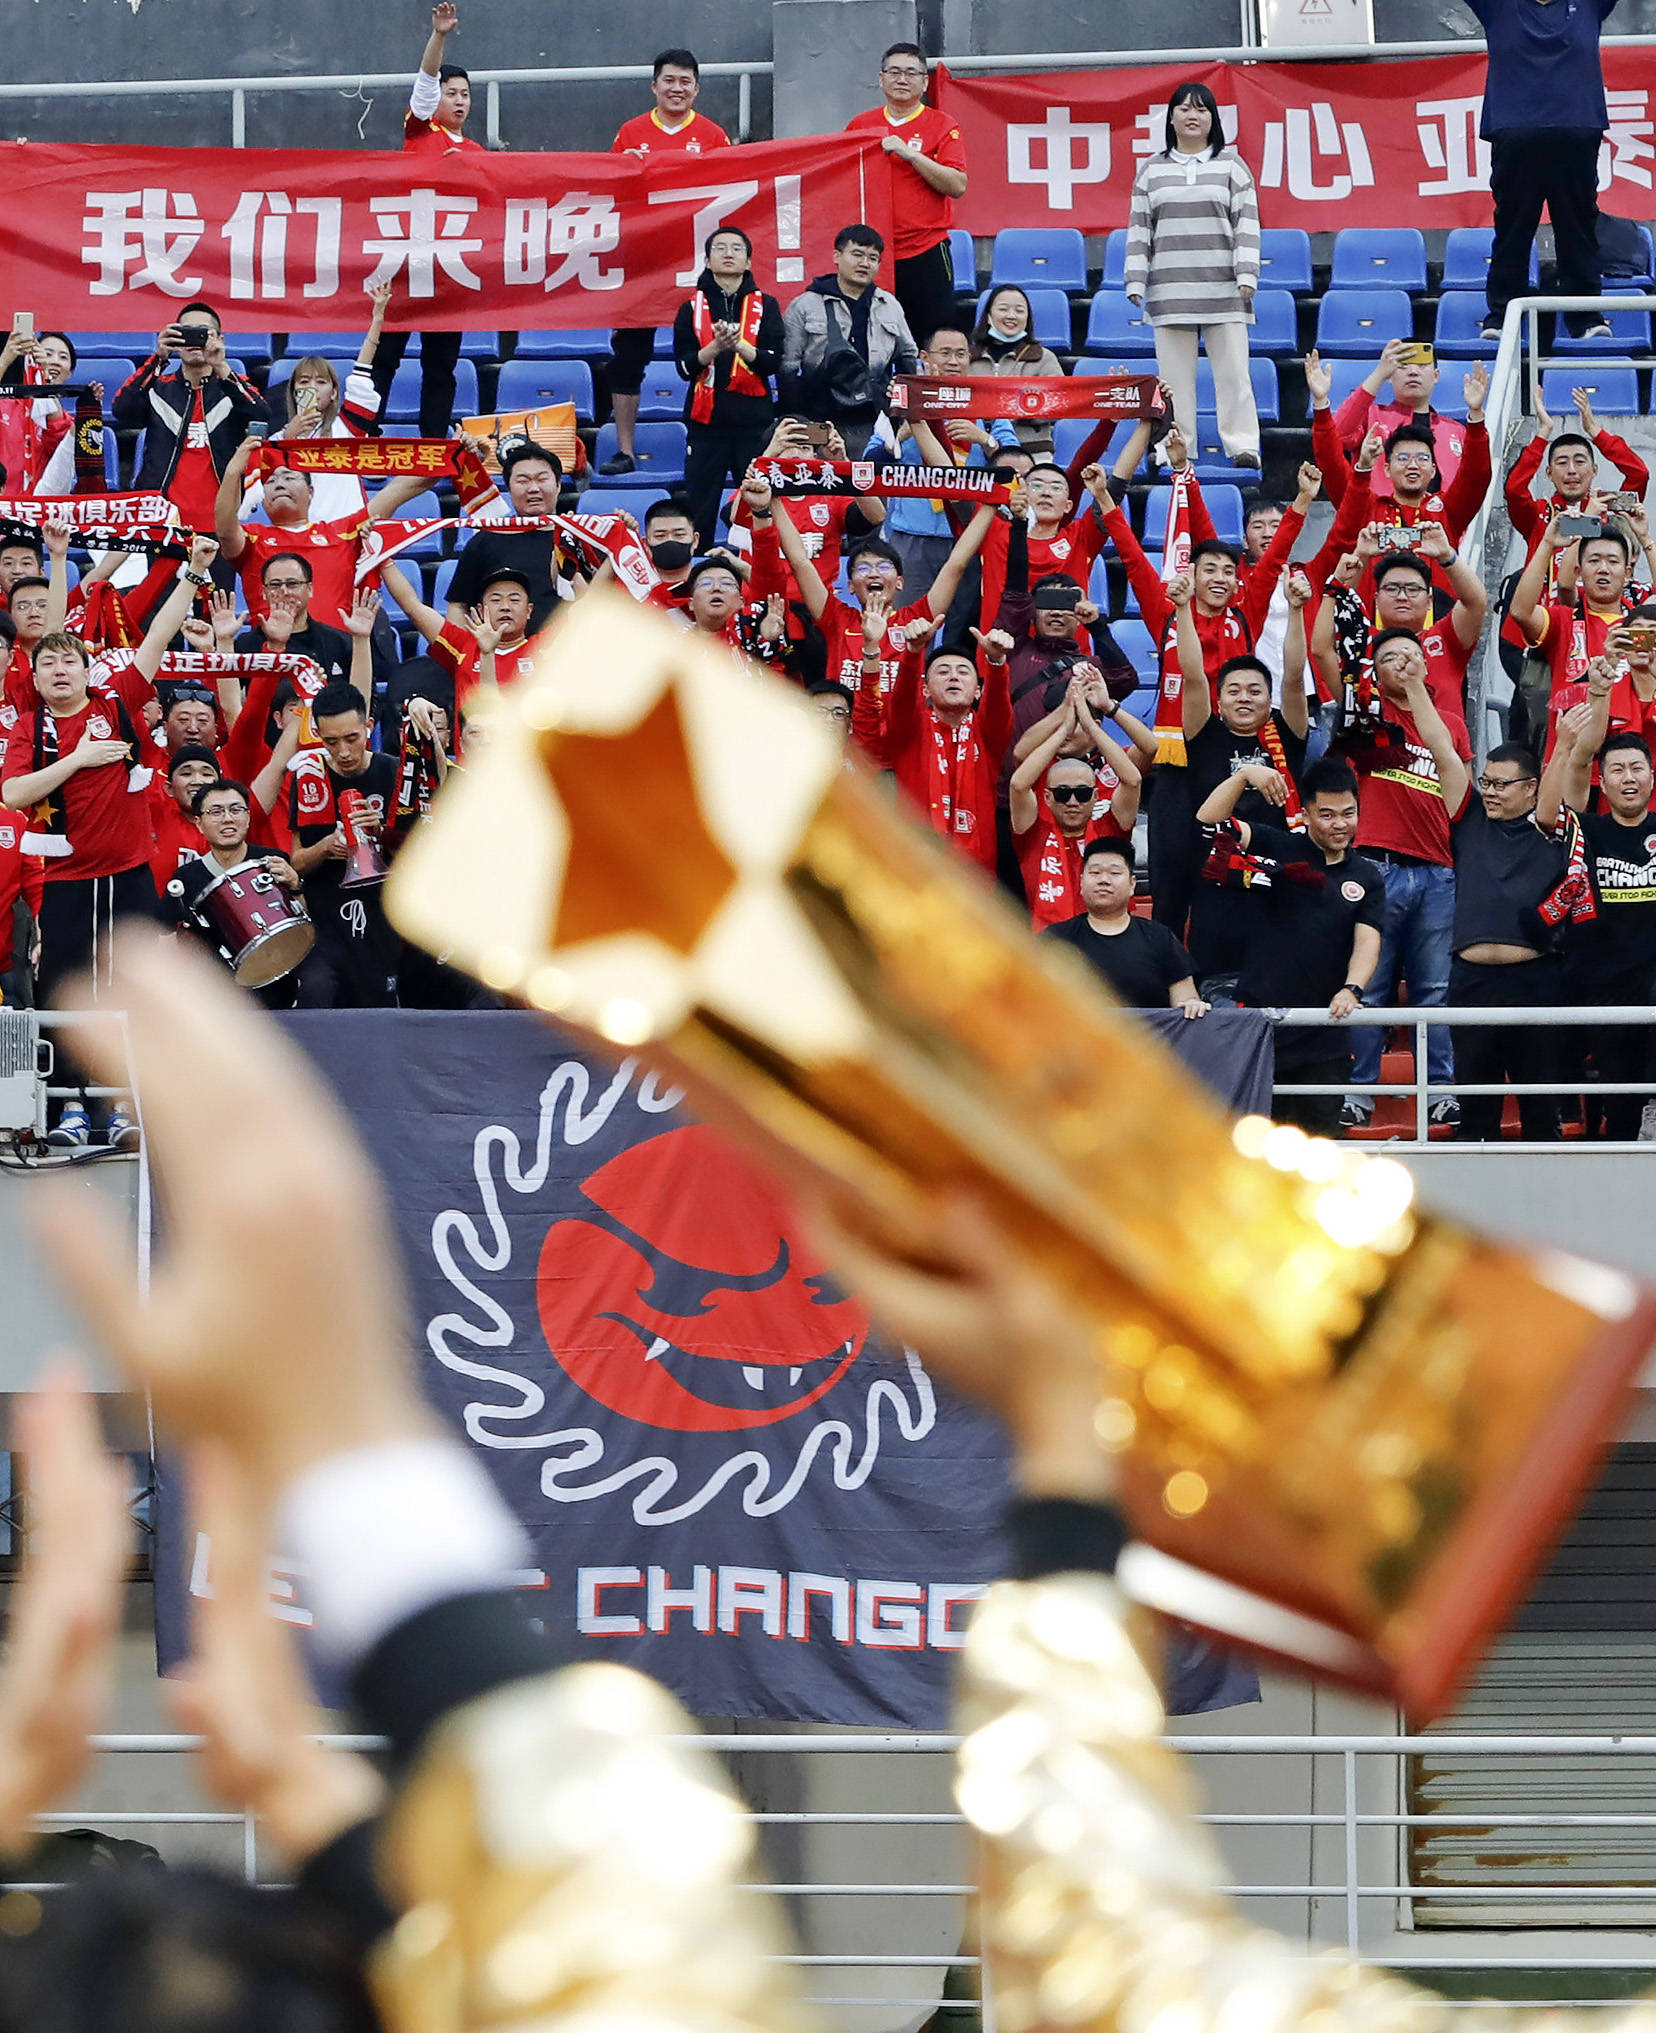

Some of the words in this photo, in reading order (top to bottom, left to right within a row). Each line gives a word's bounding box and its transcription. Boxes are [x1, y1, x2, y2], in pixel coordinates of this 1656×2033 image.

[81, 174, 804, 299] 我们来晚了!
[296, 443, 447, 472] 亚泰是冠军
[881, 465, 995, 493] CHANGCHUN
